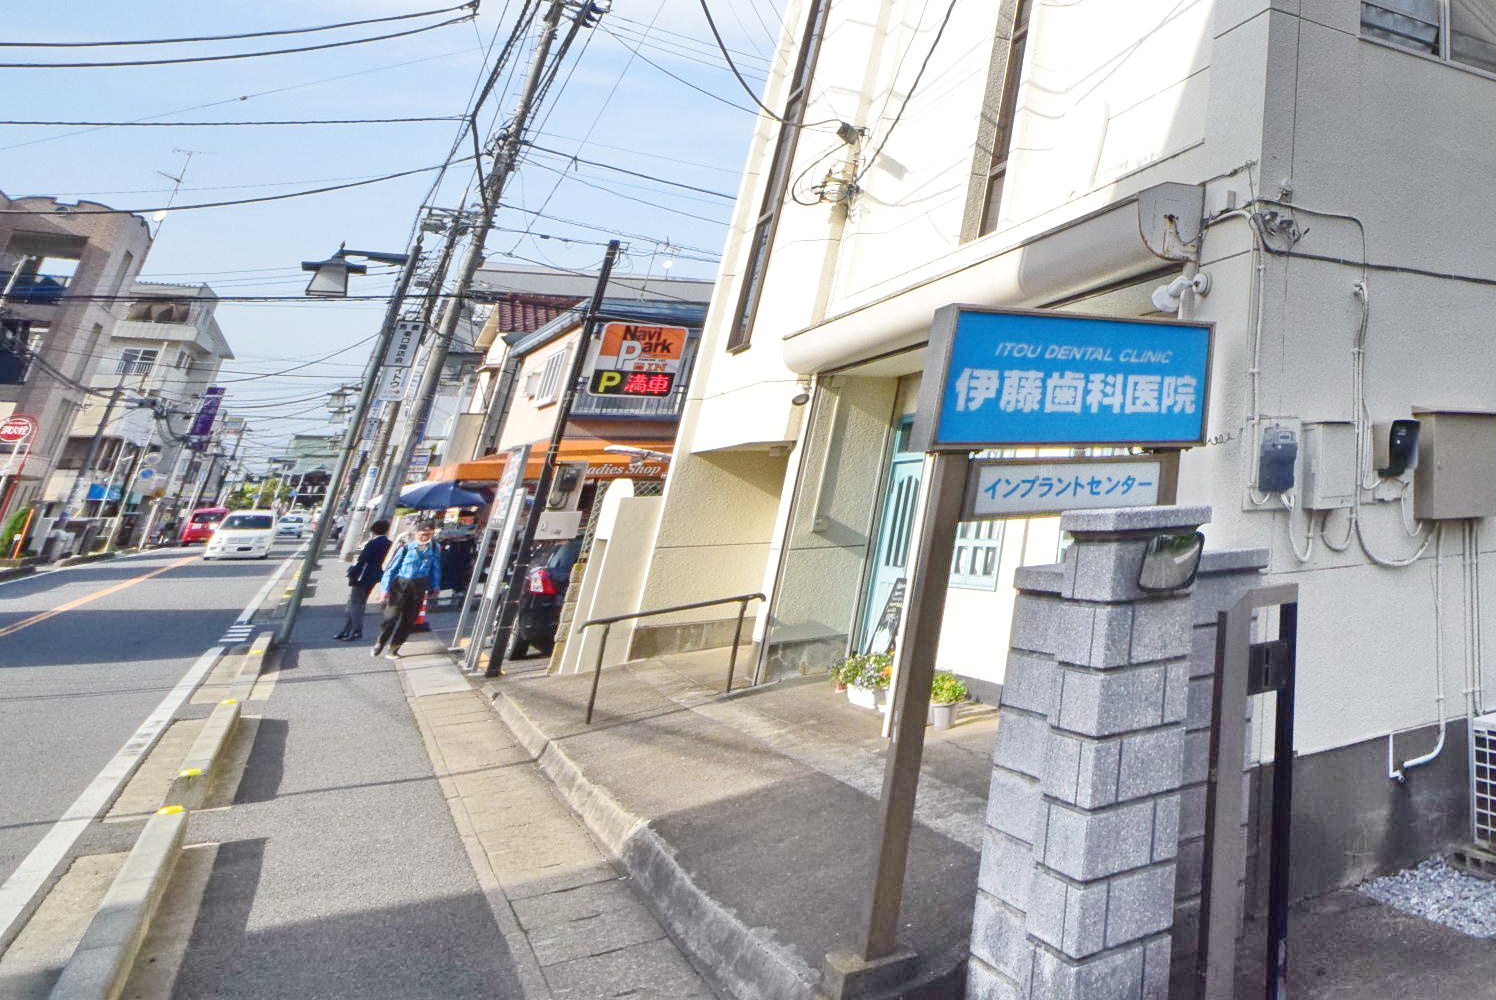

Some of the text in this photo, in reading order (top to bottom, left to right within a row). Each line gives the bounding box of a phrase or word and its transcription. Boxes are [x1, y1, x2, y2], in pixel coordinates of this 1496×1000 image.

[623, 325, 663, 341] Navi
[615, 340, 674, 370] Park
[995, 342, 1173, 365] ITOU DENTAL CLINIC
[598, 371, 621, 393] P
[624, 373, 669, 394] 満車
[955, 367, 1198, 415] 伊藤歯科医院
[586, 463, 661, 476] adies Shop
[984, 475, 1153, 499] インプラントセンター
